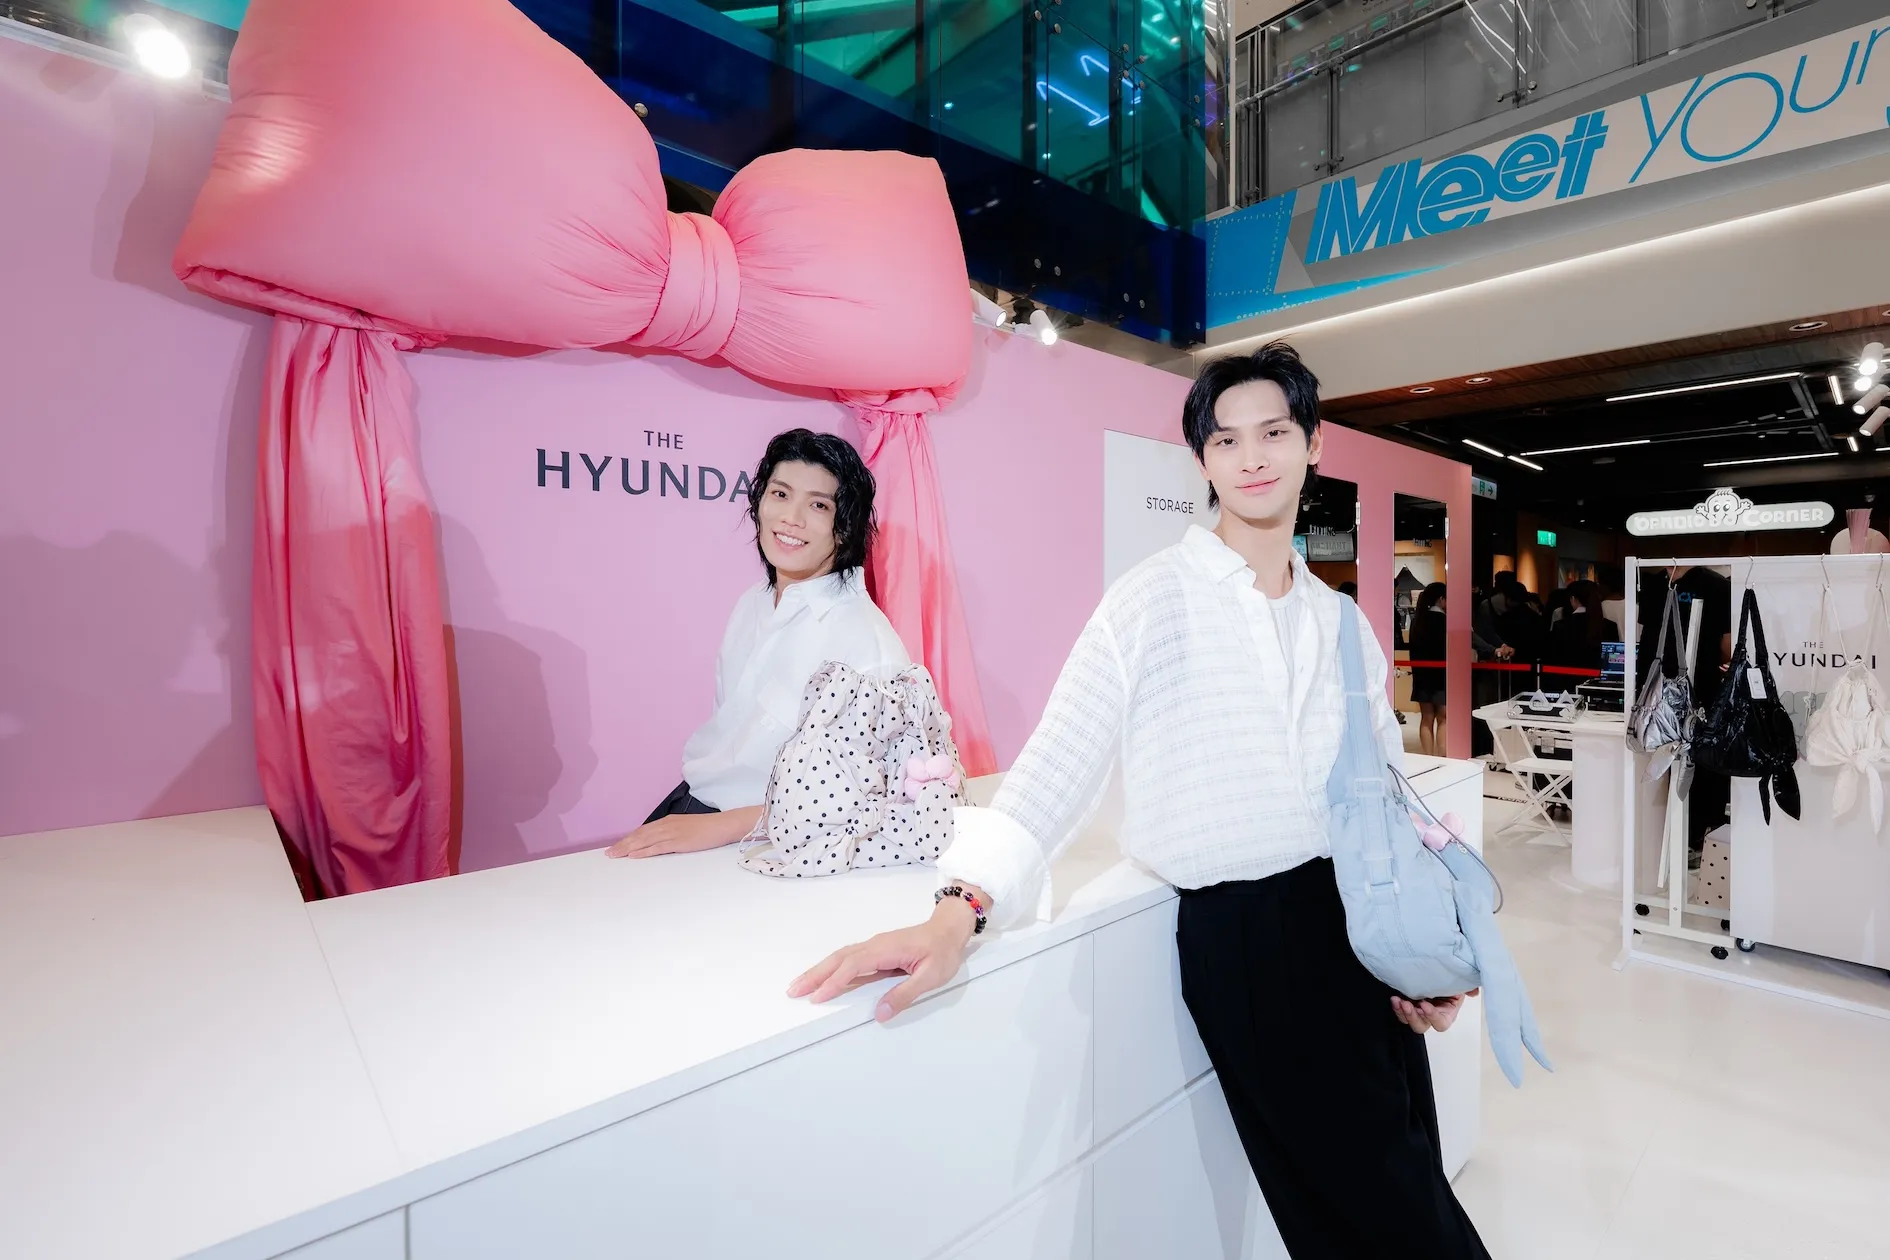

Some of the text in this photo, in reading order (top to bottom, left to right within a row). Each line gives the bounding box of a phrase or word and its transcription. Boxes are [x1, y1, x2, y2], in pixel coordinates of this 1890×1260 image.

[1304, 110, 1609, 265] Meet
[643, 430, 684, 450] THE
[536, 448, 751, 503] HYUNDA
[1146, 496, 1194, 514] STORAGE
[1742, 507, 1825, 527] CORNER
[1803, 641, 1824, 649] THE
